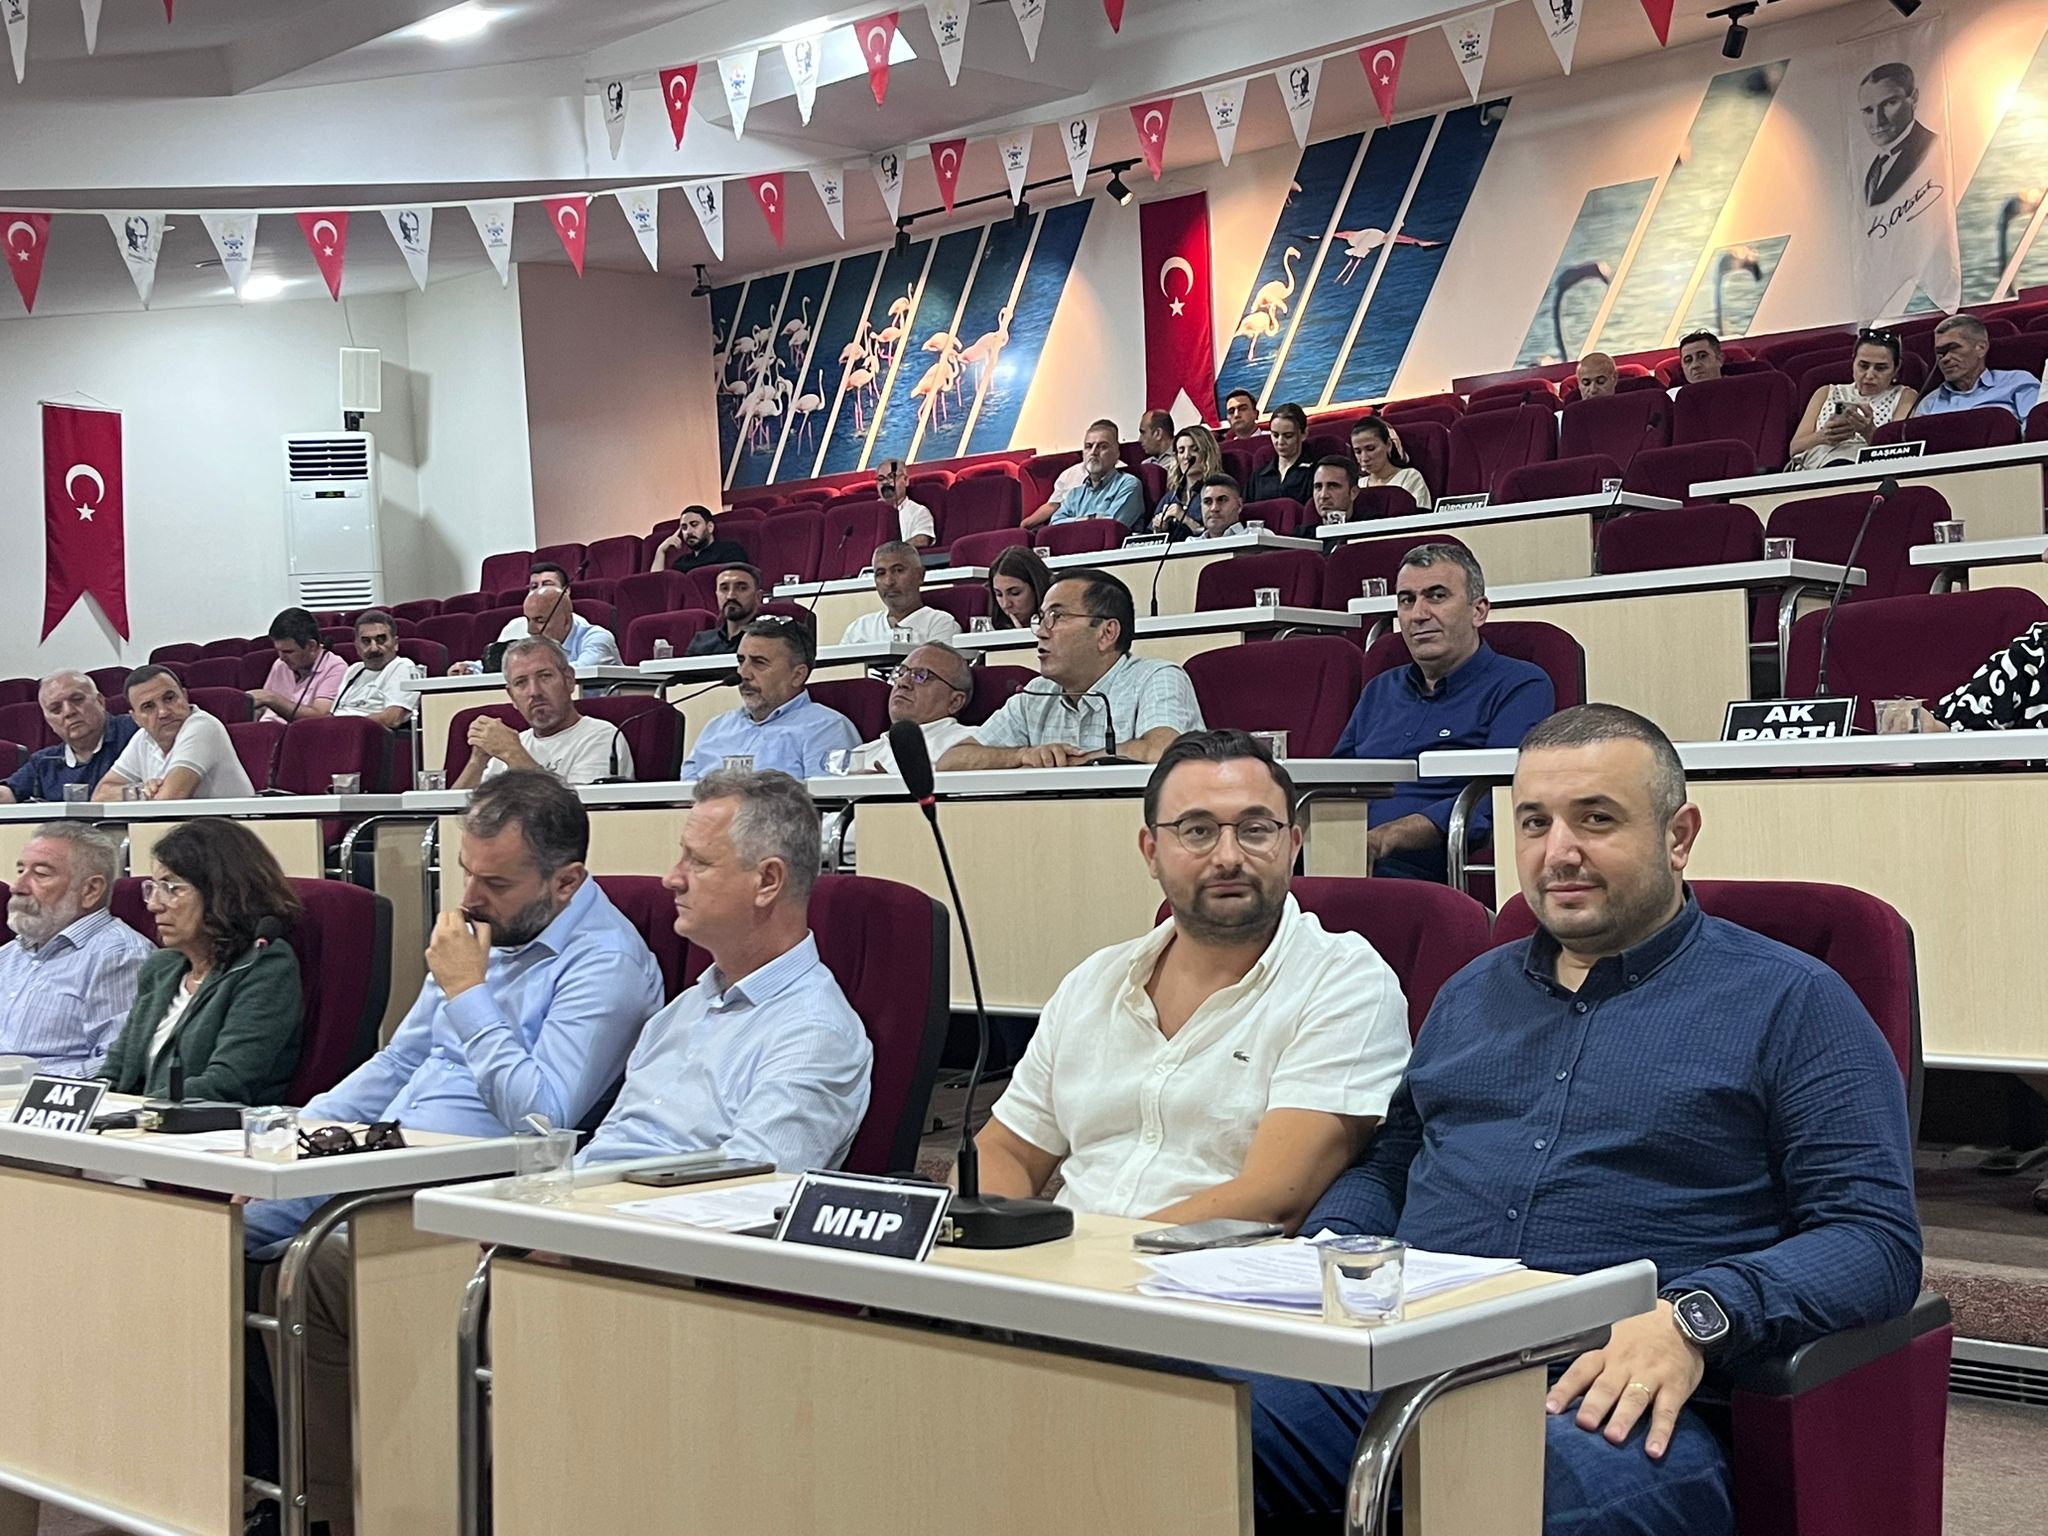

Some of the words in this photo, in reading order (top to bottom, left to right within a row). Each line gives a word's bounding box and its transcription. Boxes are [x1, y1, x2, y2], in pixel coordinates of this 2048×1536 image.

[1870, 446, 1911, 458] BAŞKAN
[1763, 704, 1815, 723] AK
[42, 1084, 82, 1107] AK
[17, 1107, 86, 1132] PARTİ
[812, 1204, 903, 1242] MHP
